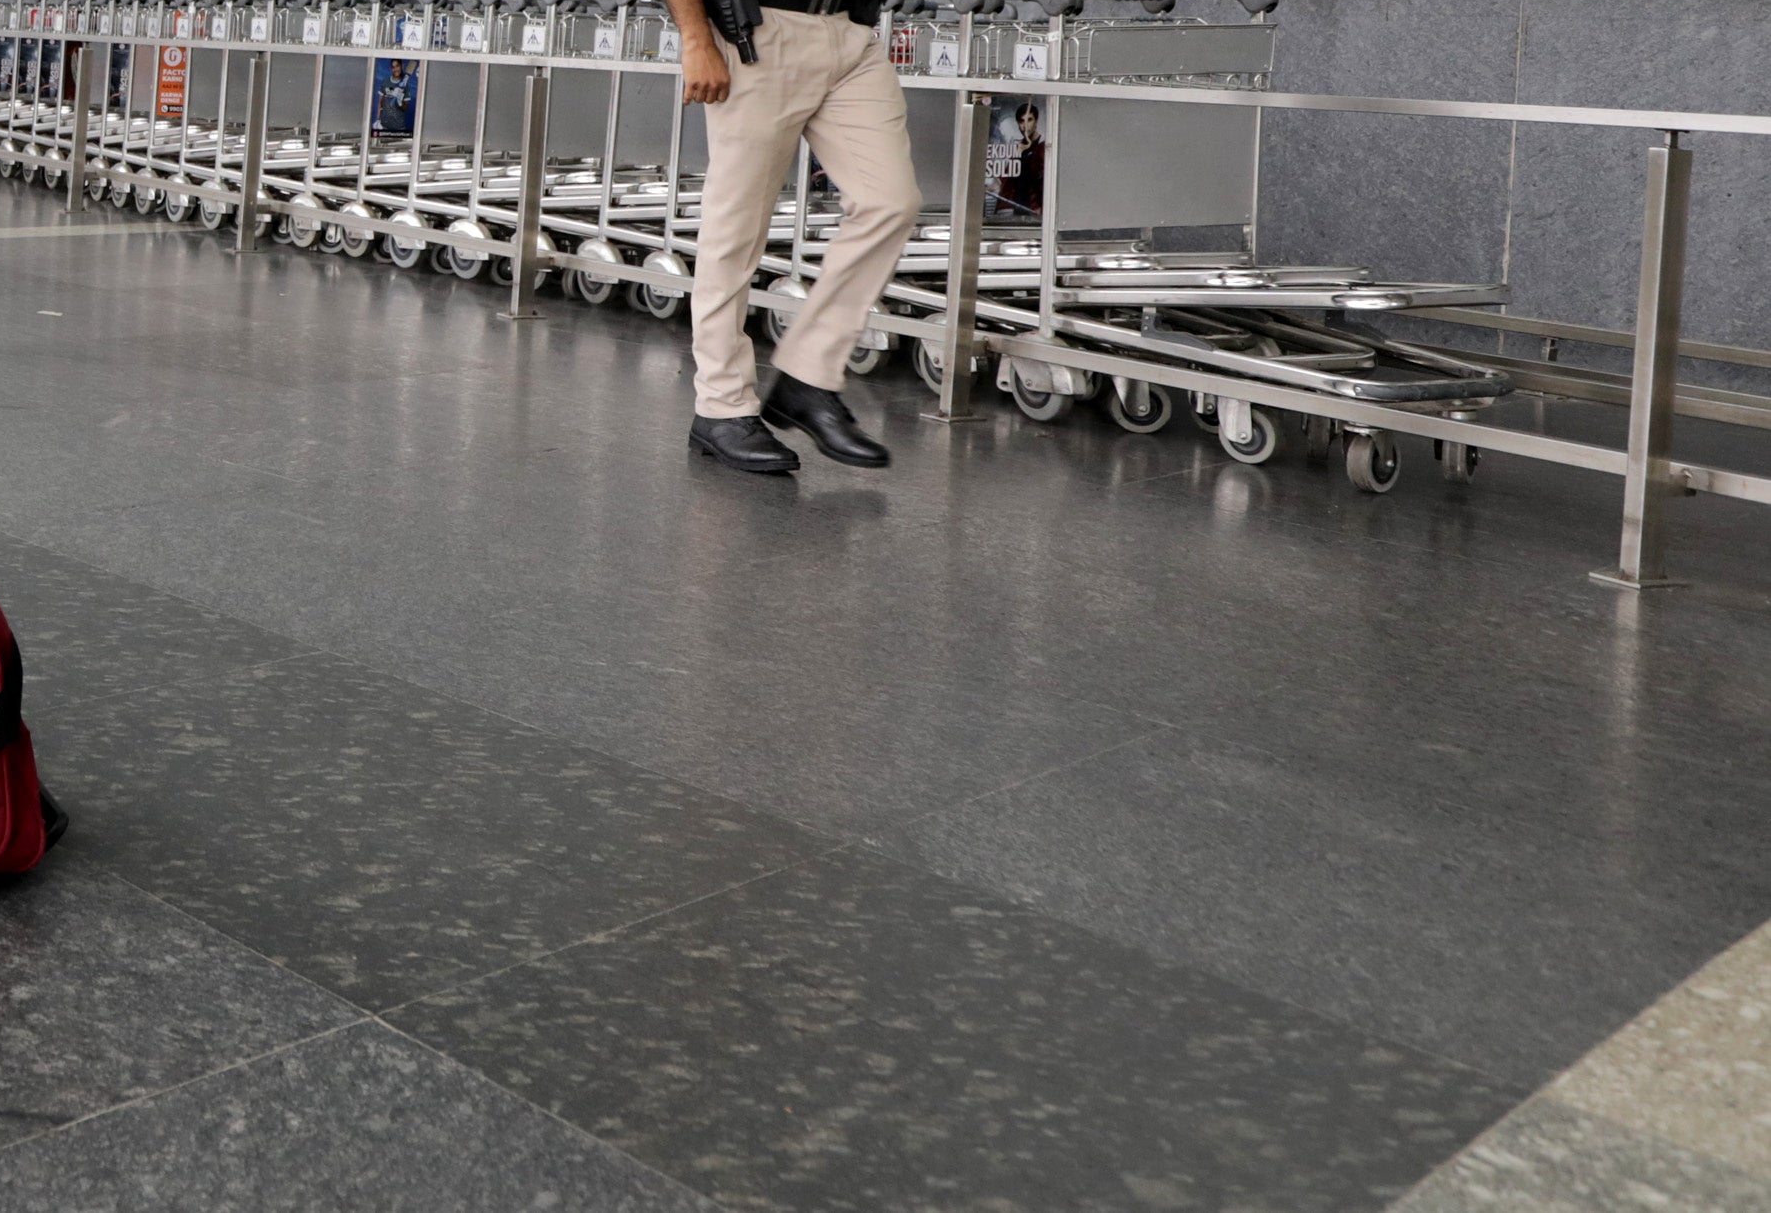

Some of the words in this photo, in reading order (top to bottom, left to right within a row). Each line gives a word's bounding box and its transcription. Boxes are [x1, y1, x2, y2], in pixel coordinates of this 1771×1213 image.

[162, 68, 186, 76] FACTO
[986, 143, 1022, 159] EKDUM
[985, 160, 1021, 177] SOLID
